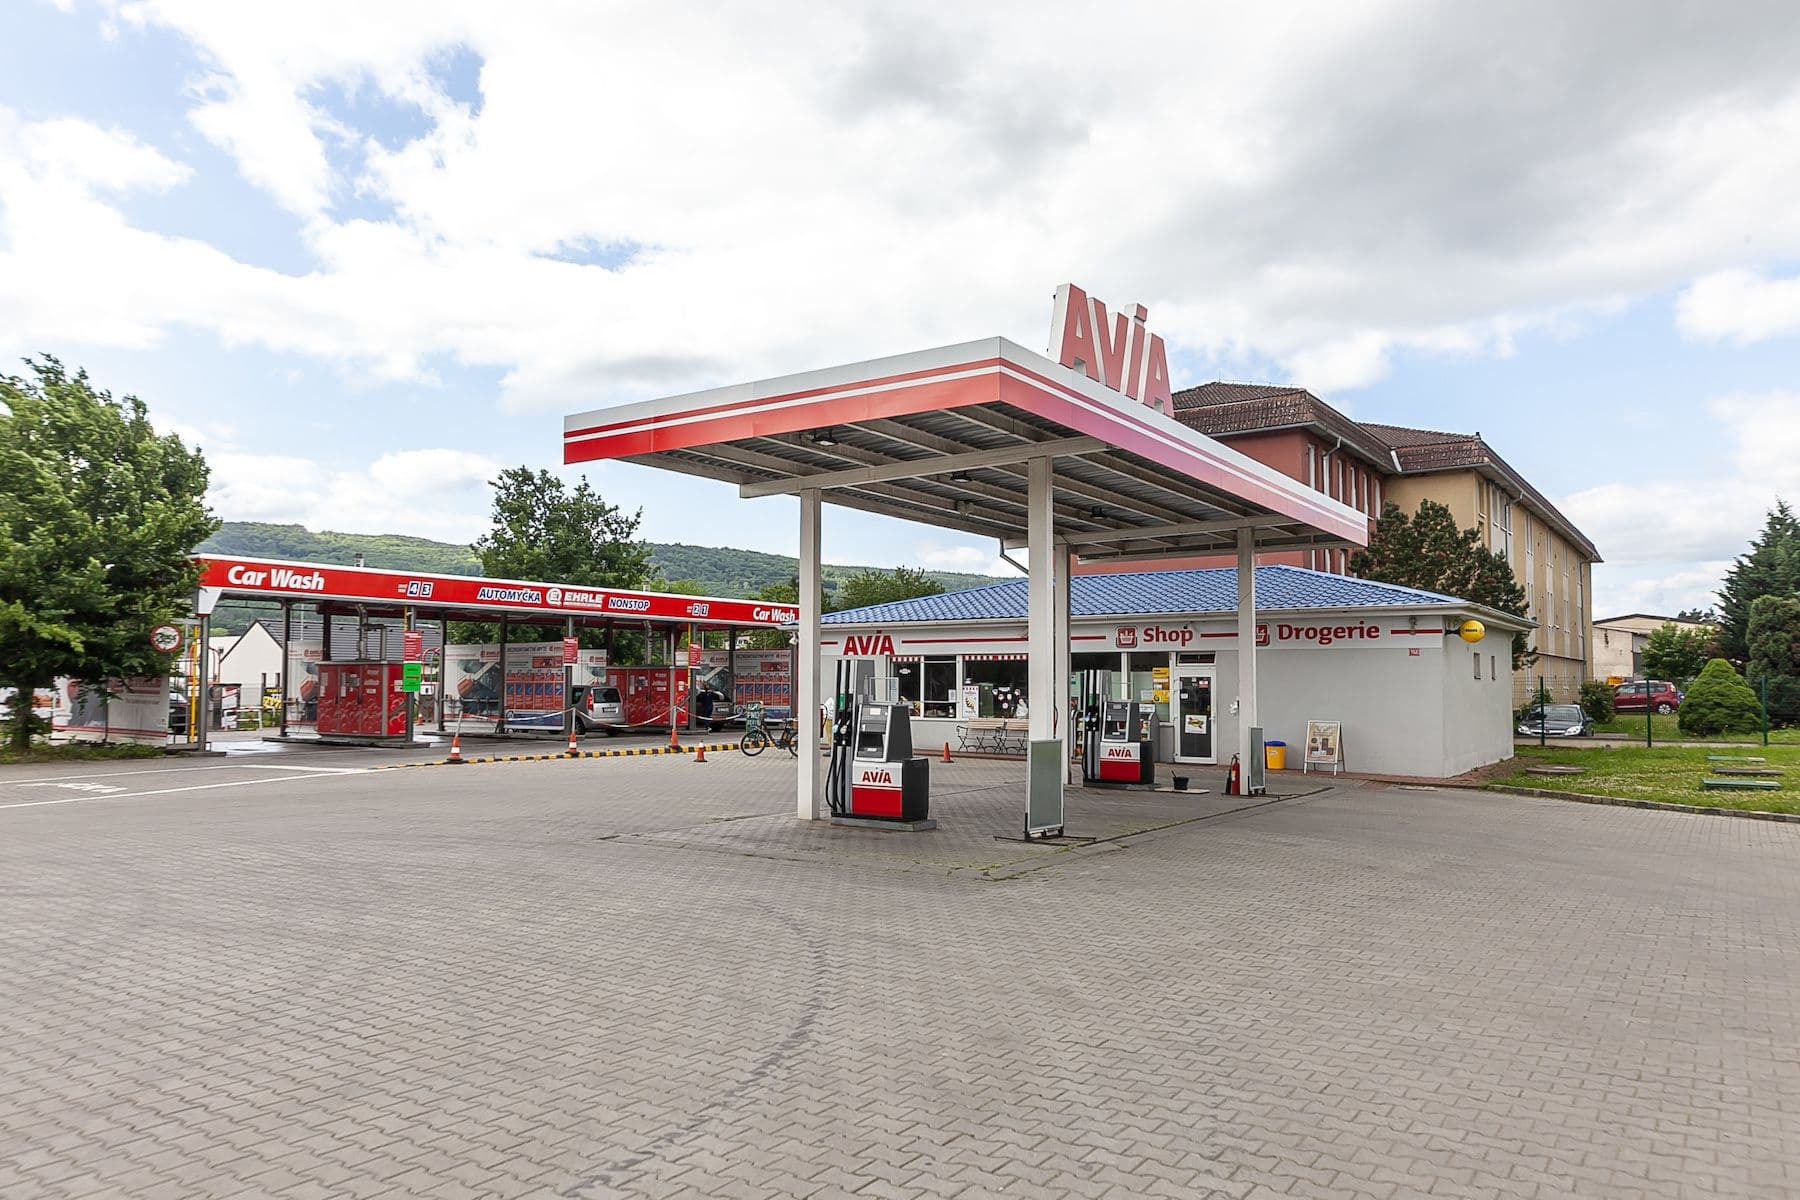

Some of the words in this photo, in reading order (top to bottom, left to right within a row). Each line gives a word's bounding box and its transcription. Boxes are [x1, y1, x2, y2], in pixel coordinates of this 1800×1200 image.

[227, 565, 267, 586] Car
[270, 568, 325, 591] Wash
[409, 582, 419, 595] 4
[421, 583, 431, 595] 3
[479, 588, 541, 603] AUTOMYČKA
[564, 591, 604, 603] EHRLE
[609, 598, 649, 610] NONSTOP
[693, 604, 700, 615] 2
[753, 608, 770, 620] Car
[771, 608, 795, 622] Wash
[1143, 626, 1193, 647] Shop
[1277, 621, 1380, 645] Drogerie
